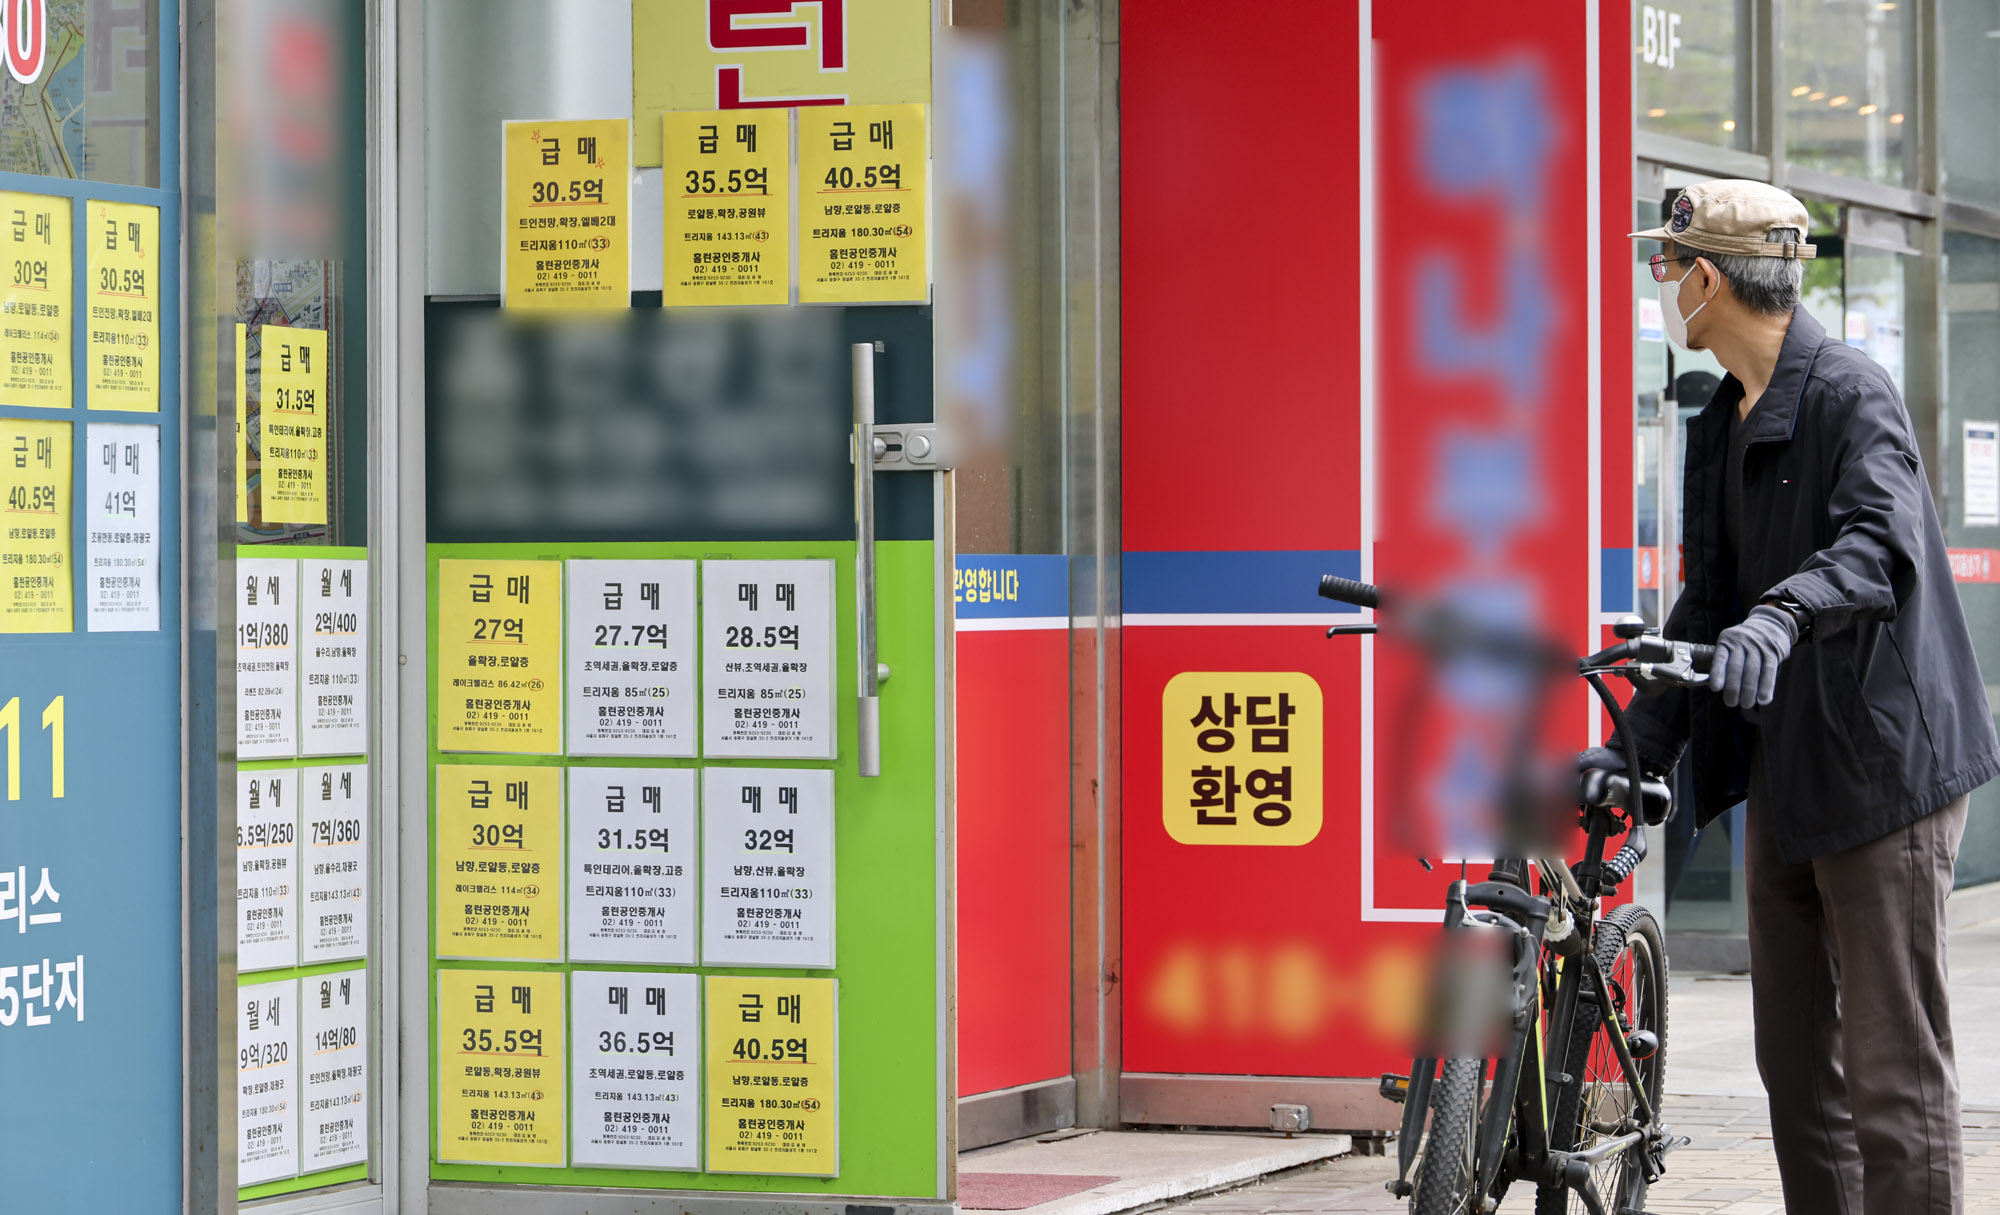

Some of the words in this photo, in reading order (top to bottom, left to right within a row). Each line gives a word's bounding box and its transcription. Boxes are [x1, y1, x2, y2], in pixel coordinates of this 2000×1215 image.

[1643, 5, 1682, 70] B1F
[686, 168, 767, 195] 35.5억
[825, 164, 900, 189] 40.5억
[533, 179, 603, 203] 30.5억
[685, 233, 712, 241] 트리지움
[813, 228, 846, 238] 트리지움
[14, 260, 47, 289] 30억
[712, 265, 727, 273] 419
[848, 261, 863, 269] 419
[875, 260, 894, 268] 0011
[101, 267, 144, 296] 30.5억
[277, 388, 314, 414] 31.5억
[9, 485, 55, 512] 40.5억
[105, 491, 135, 518] 41억
[239, 622, 288, 648] 1억/380
[316, 612, 356, 634] 2억/400
[474, 618, 523, 643] 27억
[595, 624, 667, 649] 27.7억
[726, 625, 798, 650] 28.5억
[583, 687, 619, 697] 트리지움
[718, 689, 755, 699] 트리지움
[1190, 692, 1296, 754] 상담
[1190, 765, 1292, 827] 환영
[237, 823, 294, 846] 6.5억/250
[312, 819, 360, 845] 7억/360
[473, 824, 523, 849] 30억
[599, 829, 668, 852] 31.5억
[745, 829, 793, 853] 32억
[316, 1027, 356, 1050] 14억/80
[463, 1028, 542, 1056] 35.5억
[599, 1031, 673, 1056] 36.5억
[733, 1038, 807, 1063] 40.5억
[241, 1042, 287, 1069] 9억/320
[462, 1089, 489, 1098] 트리지움
[595, 1092, 623, 1100] 트리지움
[722, 1098, 755, 1108] 트리지움
[605, 1124, 618, 1132] 02)
